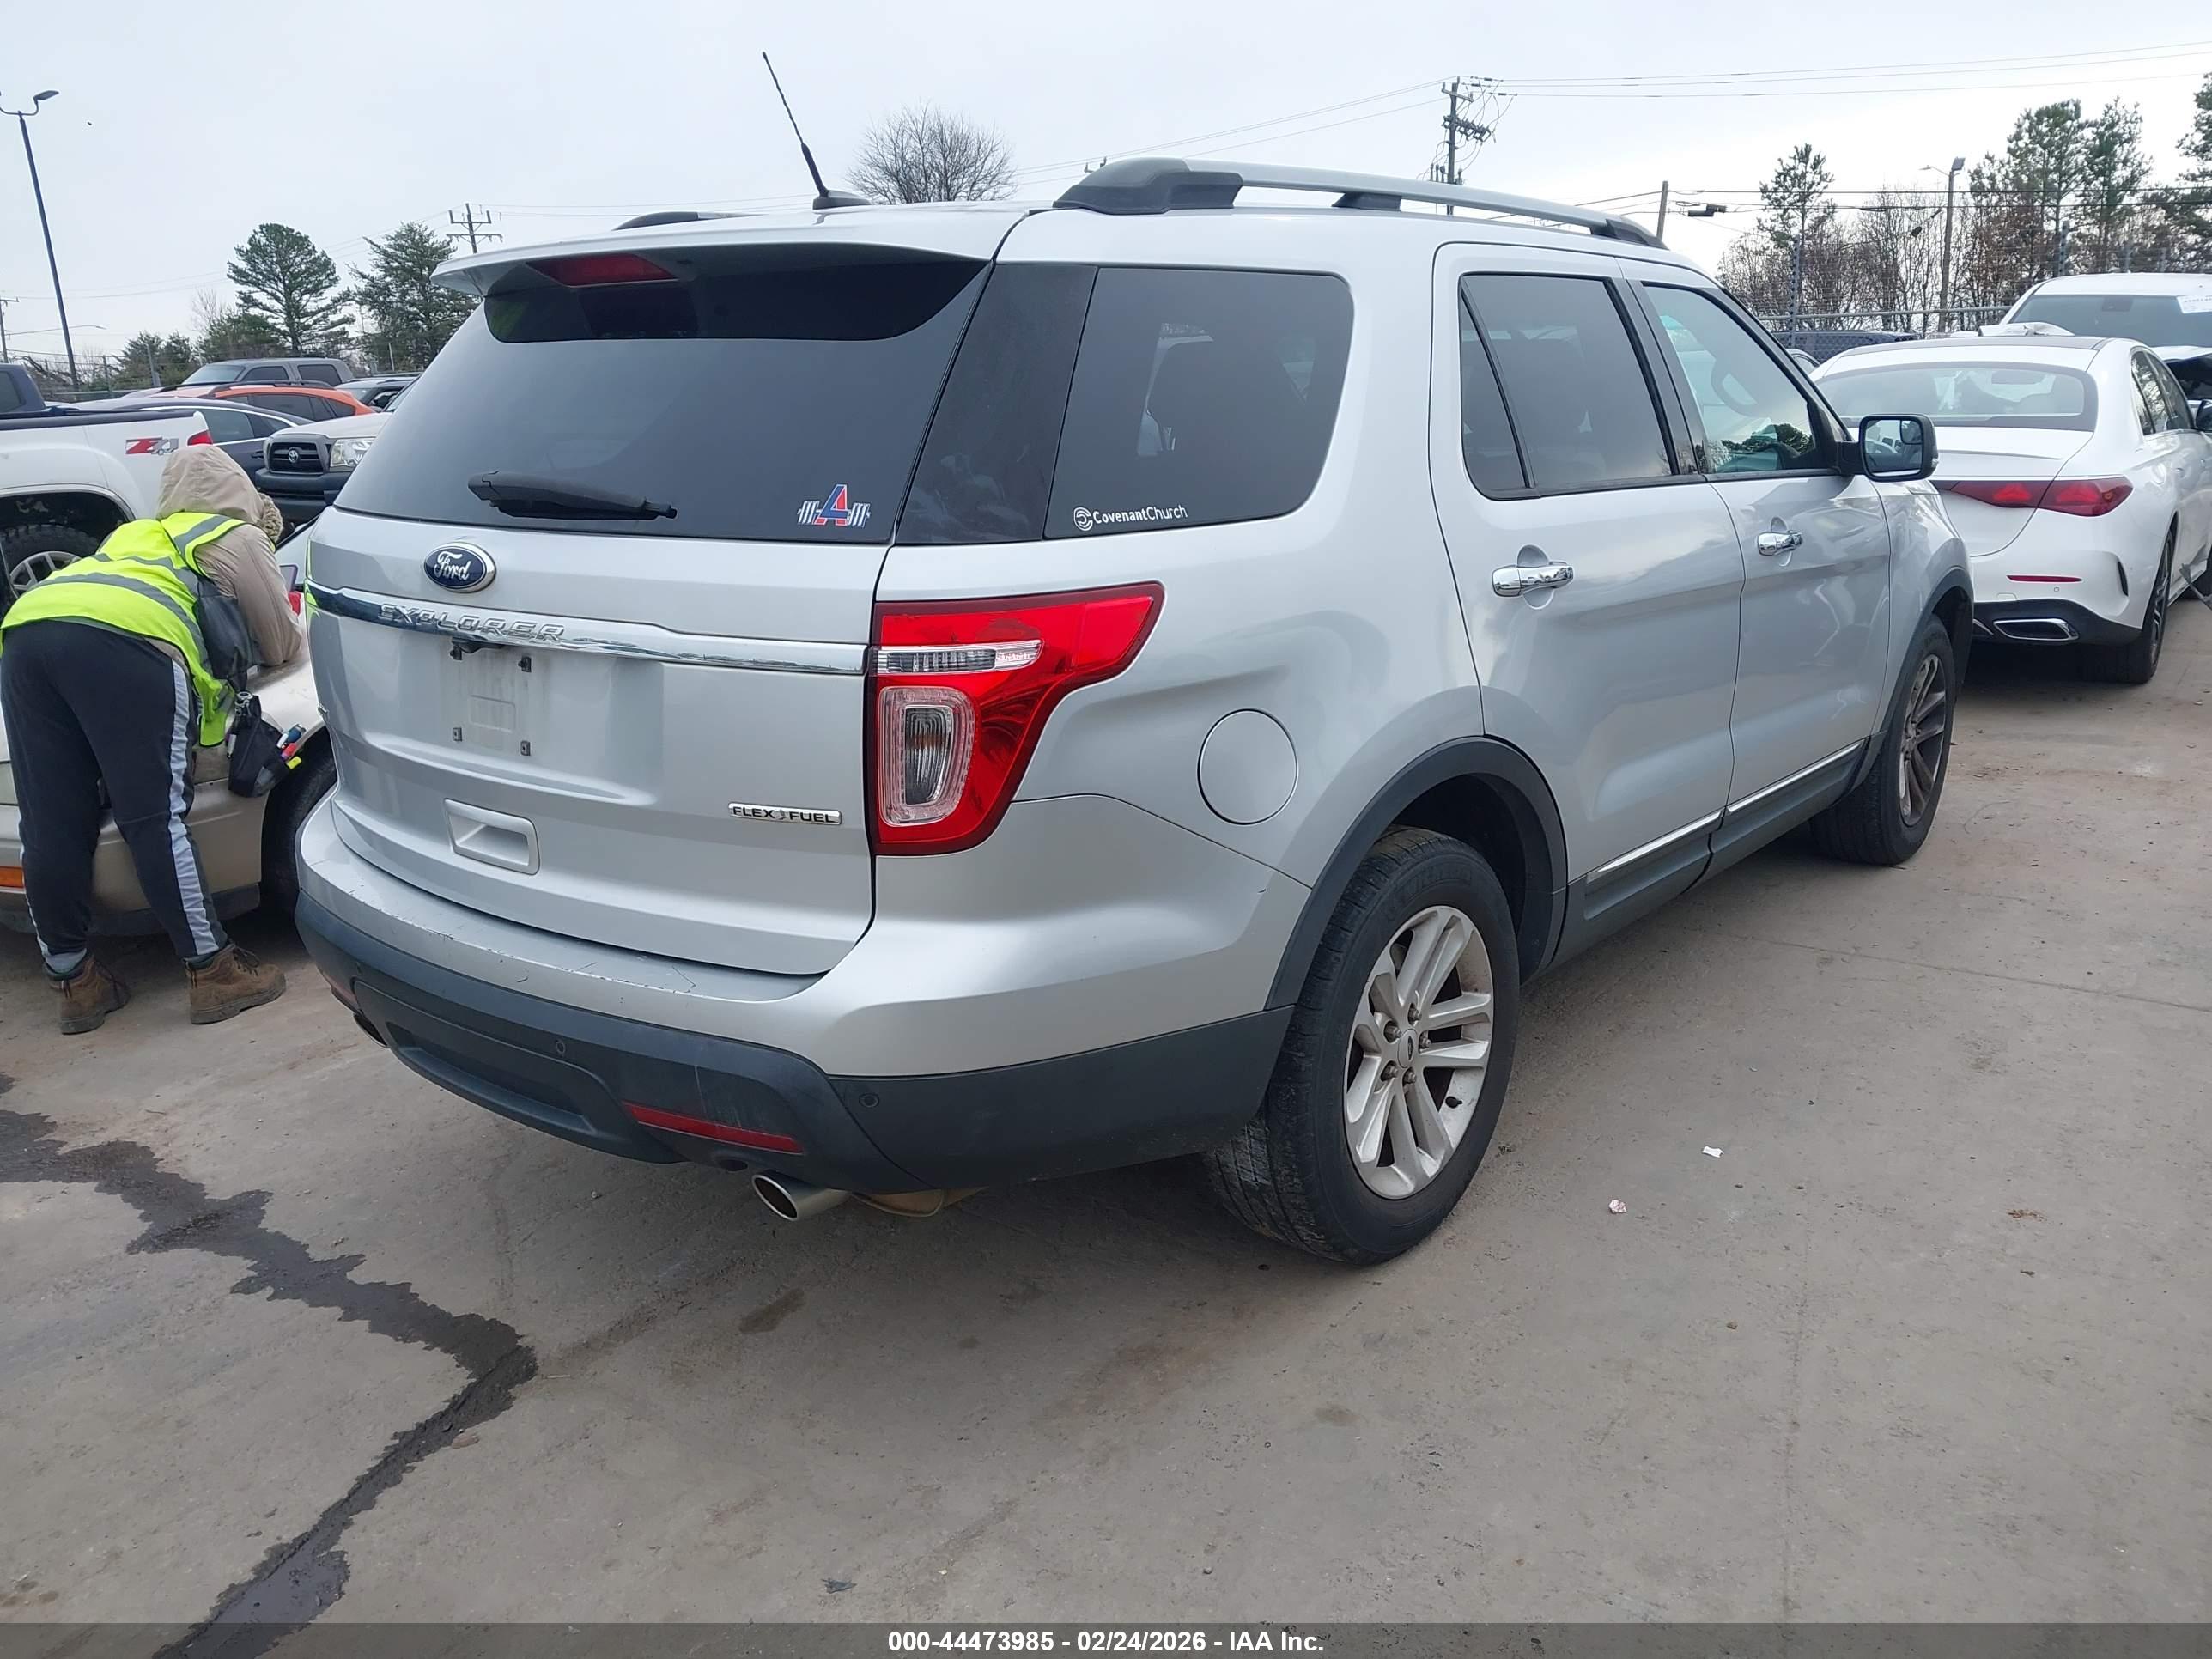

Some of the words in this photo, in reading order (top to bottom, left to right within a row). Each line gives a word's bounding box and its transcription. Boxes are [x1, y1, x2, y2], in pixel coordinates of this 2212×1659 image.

[1093, 504, 1188, 524] CovenantChurch
[434, 550, 471, 580] Ford
[378, 603, 565, 642] EXPLORER
[732, 806, 775, 819] FLEX
[788, 811, 839, 823] FUEL
